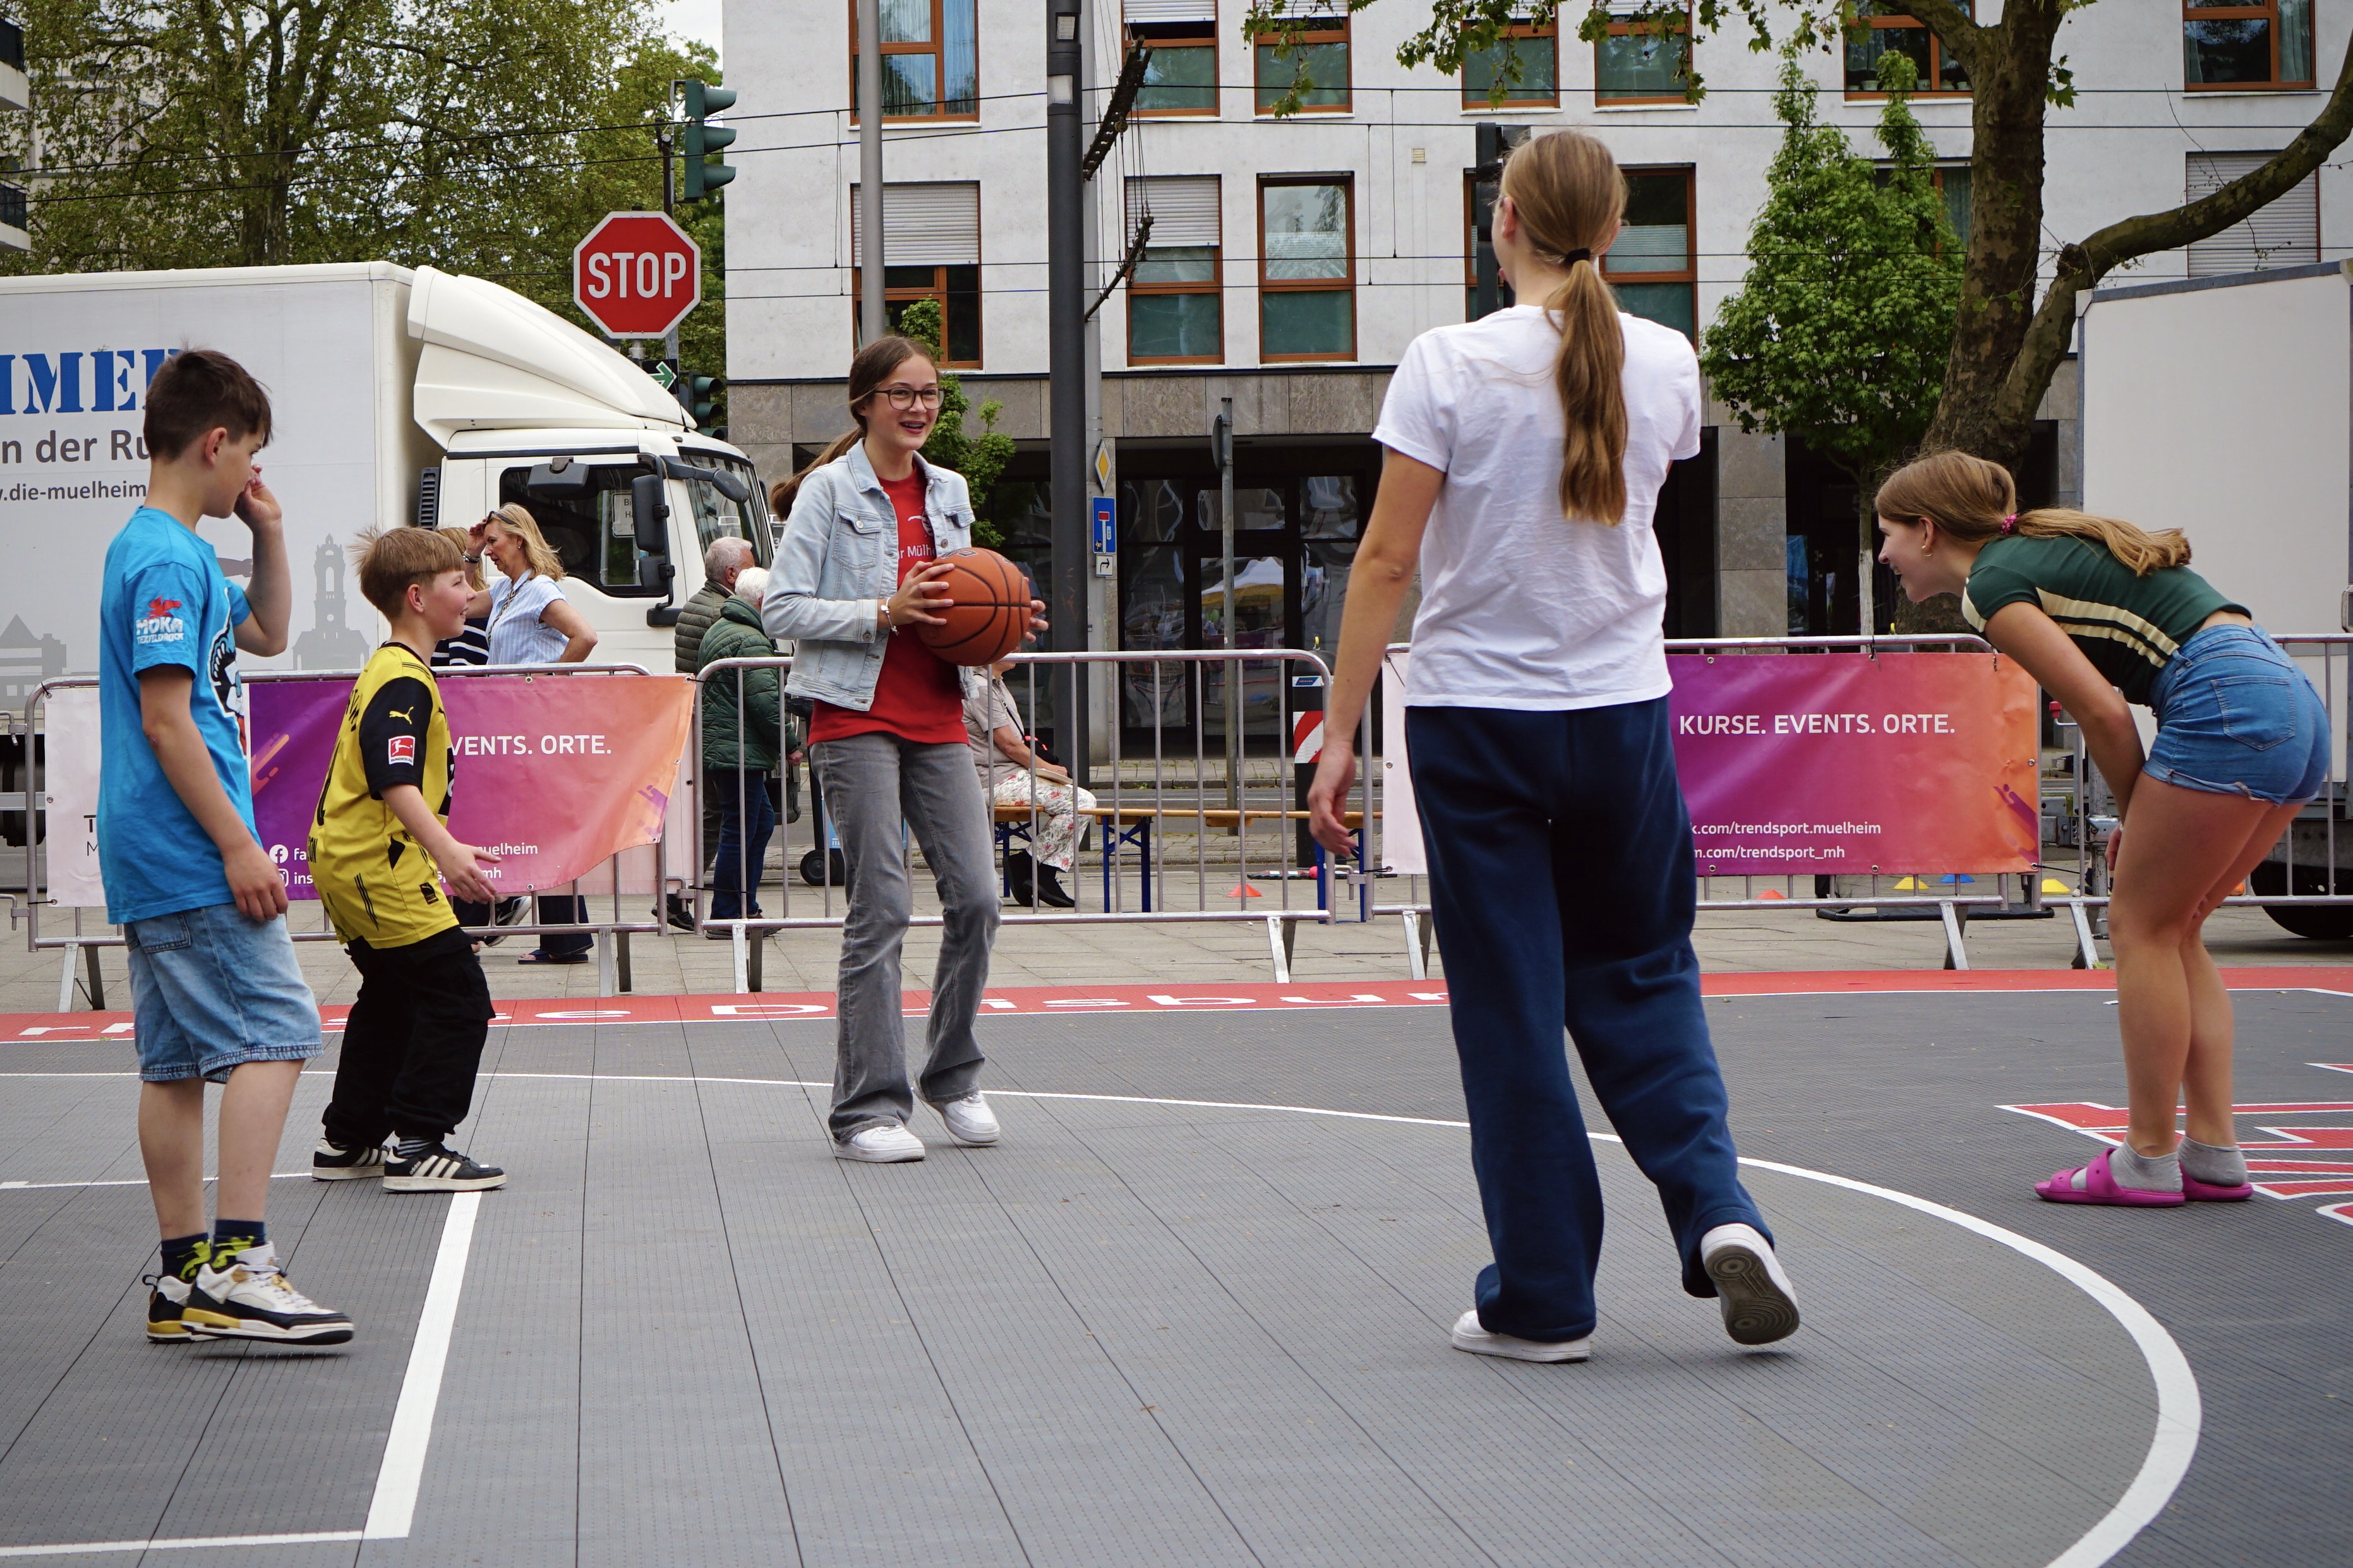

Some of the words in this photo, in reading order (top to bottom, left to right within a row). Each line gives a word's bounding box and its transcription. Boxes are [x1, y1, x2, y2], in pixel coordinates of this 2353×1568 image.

[587, 252, 687, 299] STOP
[0, 349, 185, 415] IME
[35, 430, 97, 463] der
[136, 616, 184, 635] MOKA
[1680, 715, 1766, 735] KURSE.
[1774, 714, 1876, 734] EVENTS.
[1883, 714, 1955, 734] ORTE.
[452, 735, 533, 756] VENTS.
[541, 734, 612, 755] ORTE.
